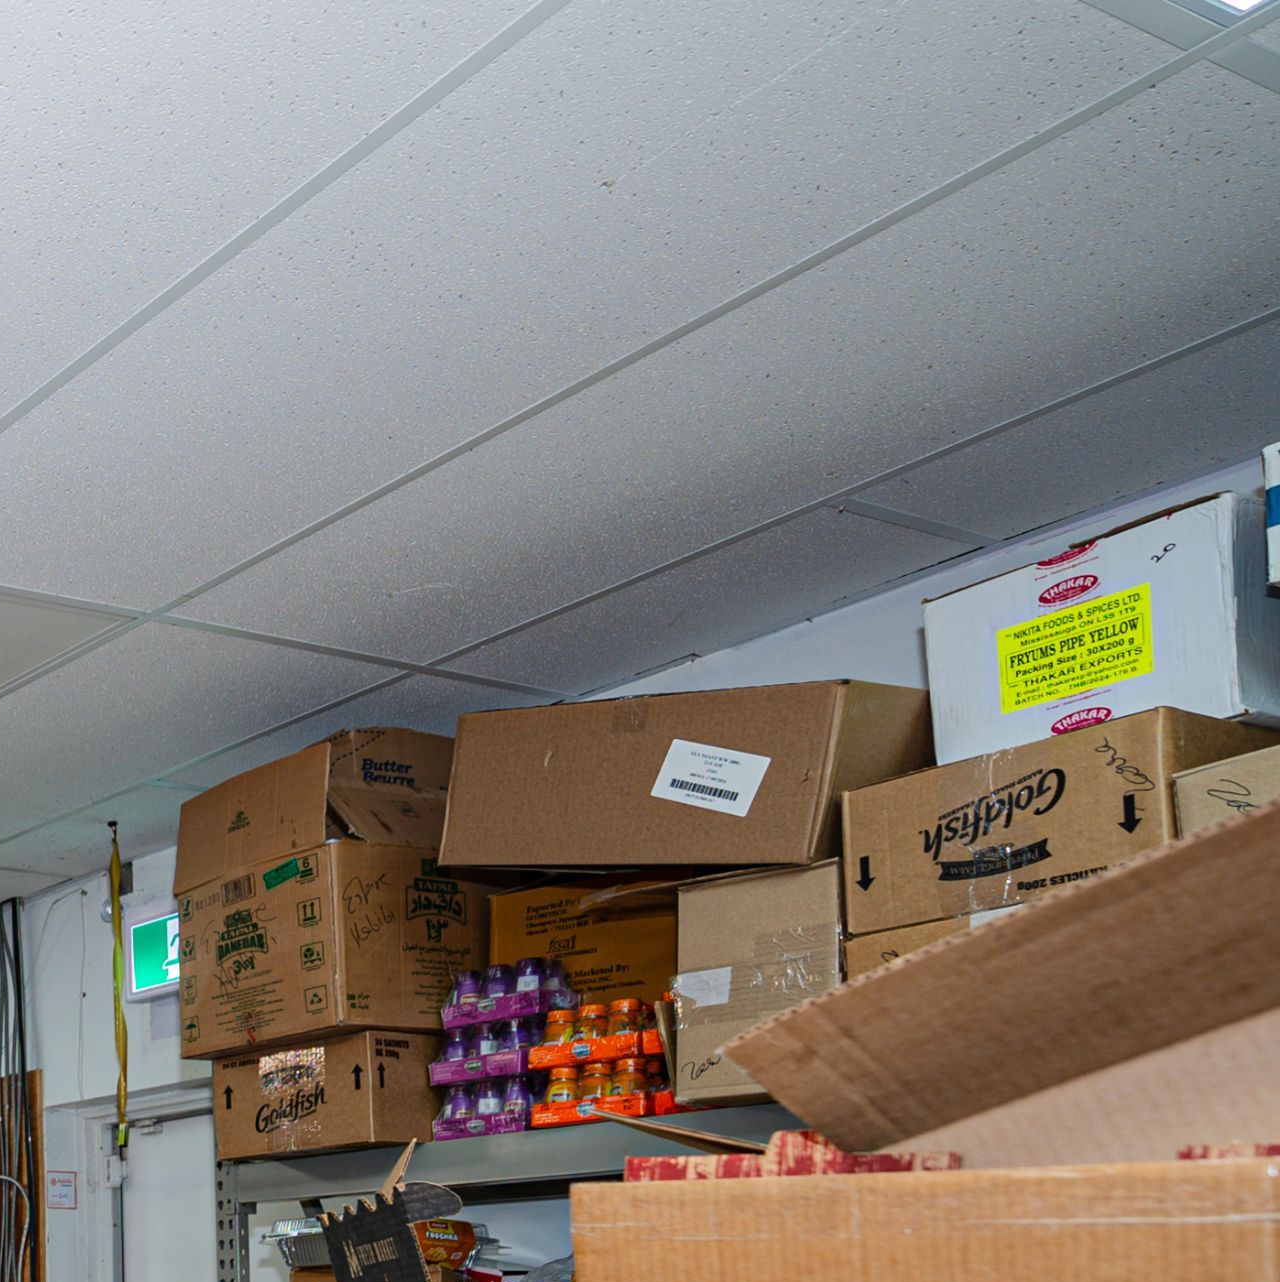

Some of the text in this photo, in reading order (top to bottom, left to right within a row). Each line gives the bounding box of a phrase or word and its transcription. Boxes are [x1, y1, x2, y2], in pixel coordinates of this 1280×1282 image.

[1042, 575, 1096, 601] THAKAR
[1013, 625, 1041, 640] NIKITA
[1043, 613, 1075, 631] FOODS
[1086, 599, 1120, 614] SPICES
[1020, 626, 1076, 646] Mississauga
[1079, 619, 1094, 628] ON
[1009, 617, 1139, 669] FRYUMS PIPE YELLOW
[1015, 660, 1054, 678] Packing
[1057, 654, 1077, 665] Size
[1086, 640, 1125, 656] 30X200
[1023, 646, 1143, 688] THAKAR EXPORTS
[1054, 708, 1109, 730] THAKAR
[361, 758, 413, 775] Butter
[363, 771, 416, 787] Beurre
[918, 767, 1067, 866] Goldfish
[301, 857, 310, 869] 6
[1016, 876, 1048, 892] 200g
[255, 1082, 327, 1133] Goldfish
